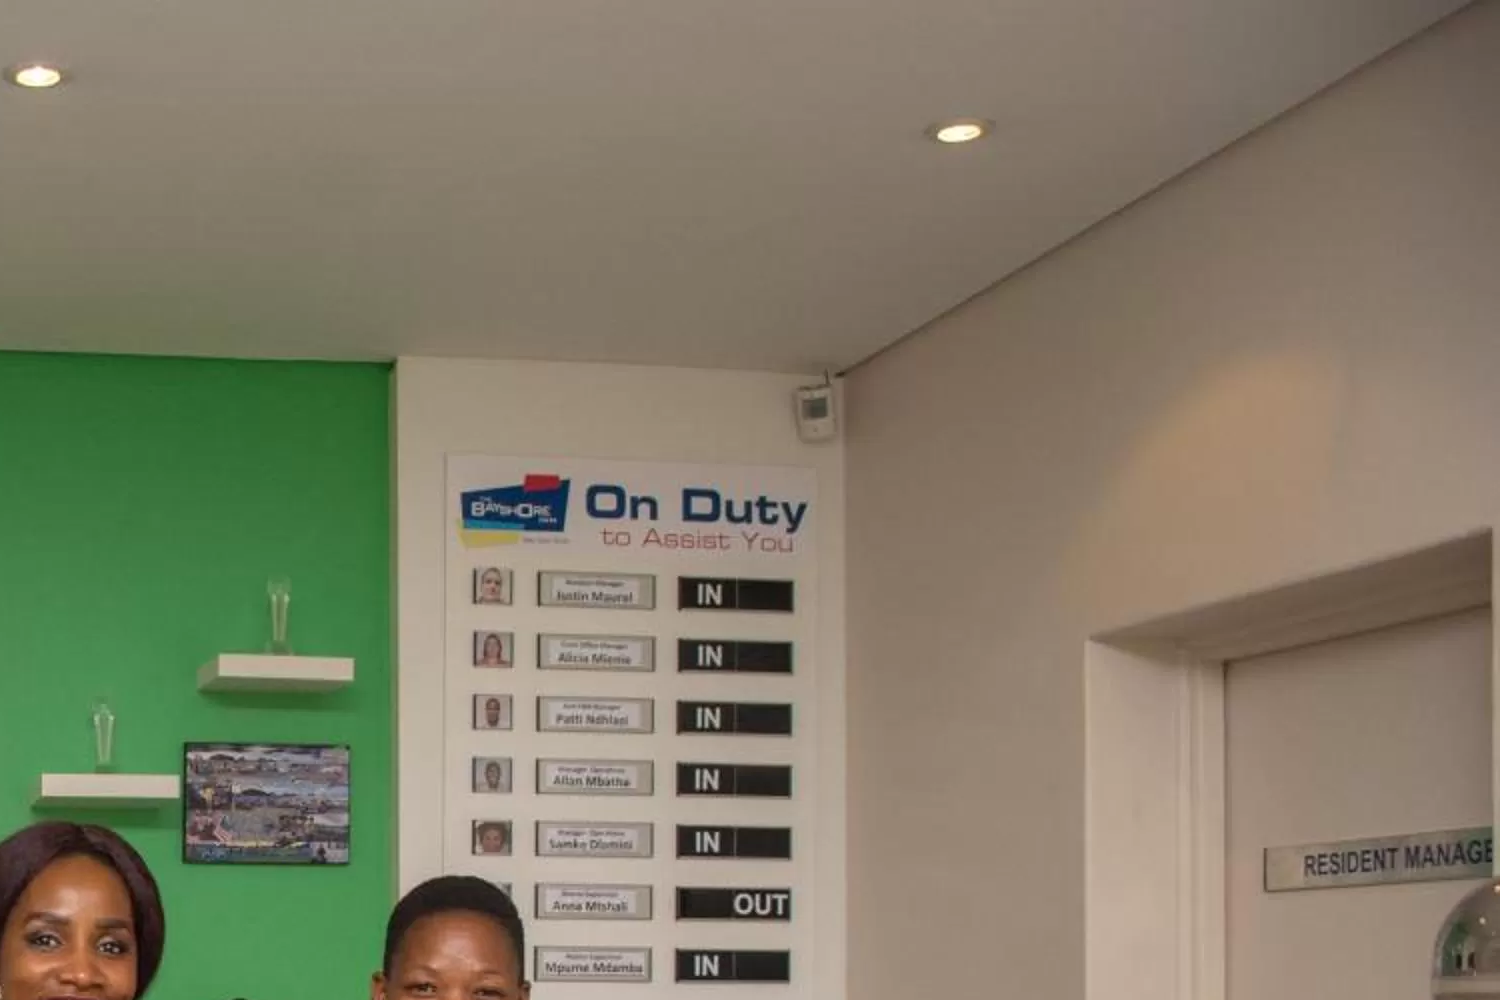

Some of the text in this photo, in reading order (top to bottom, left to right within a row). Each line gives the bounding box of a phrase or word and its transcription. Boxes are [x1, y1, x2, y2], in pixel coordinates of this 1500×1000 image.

[586, 484, 807, 534] On Duty
[600, 527, 794, 553] to Assist You
[697, 583, 723, 605] IN
[697, 645, 723, 667] IN
[696, 707, 722, 729] IN
[694, 769, 720, 791] IN
[694, 831, 720, 853] IN
[1303, 847, 1399, 877] RESIDENT
[733, 893, 789, 916] OUT
[693, 955, 719, 977] IN
